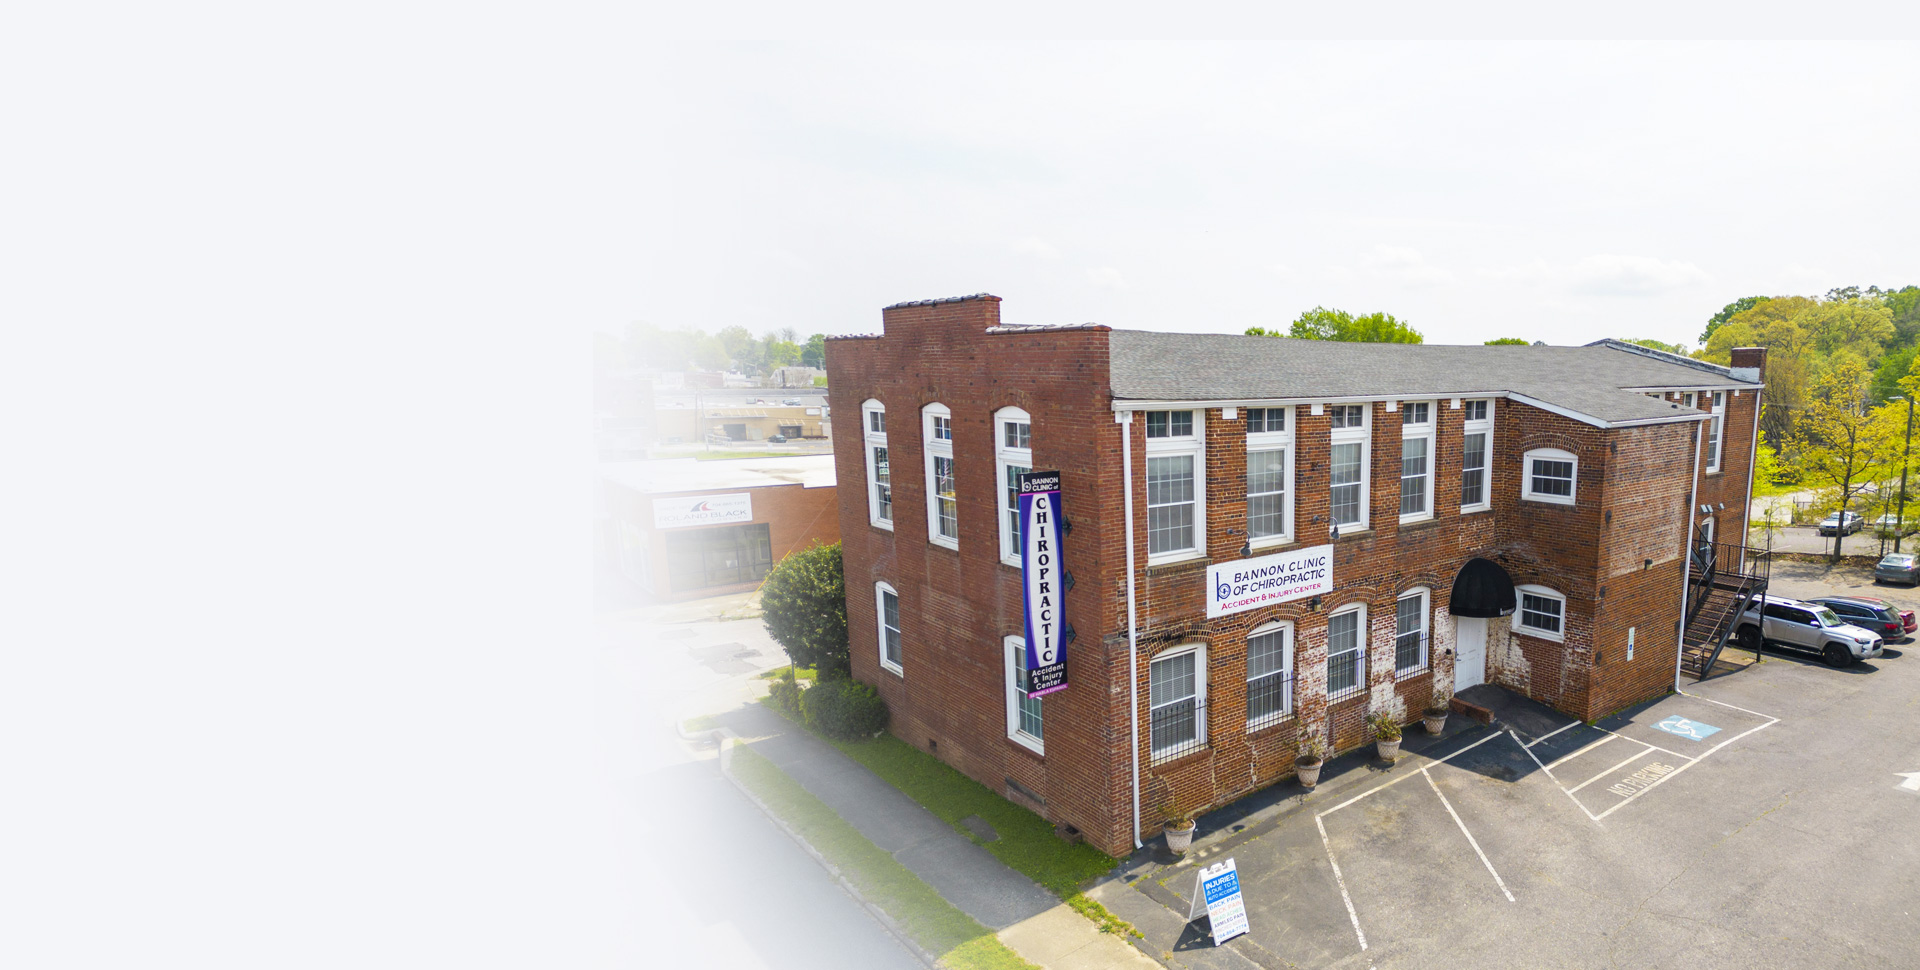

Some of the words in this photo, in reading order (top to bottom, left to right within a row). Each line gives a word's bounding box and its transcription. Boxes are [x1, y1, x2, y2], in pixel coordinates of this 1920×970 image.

[1031, 477, 1058, 485] BANNON
[710, 510, 747, 518] BLACK
[1234, 564, 1285, 583] BANNON
[1288, 556, 1326, 572] CLINIC
[1036, 497, 1053, 662] CHIROPRACTIC
[1233, 584, 1248, 596] OF
[1250, 568, 1326, 592] CHIROPRACTIC
[1221, 596, 1260, 610] ACCIDENT
[1268, 589, 1293, 600] INJURY
[1294, 583, 1321, 594] CENTER
[1032, 663, 1064, 677] Accident
[1042, 672, 1062, 682] Injury
[1036, 679, 1061, 690] Center
[1606, 784, 1637, 798] NO
[1622, 762, 1674, 788] PARKING
[1206, 873, 1235, 890] INJURIES
[1212, 885, 1224, 894] DUE
[1208, 894, 1218, 902] AUTO
[1218, 886, 1238, 898] ACCIDENT
[1209, 900, 1226, 910] BACK
[1226, 894, 1240, 903] PAIN
[1211, 907, 1226, 916] NECK
[1228, 900, 1242, 910] PAIN
